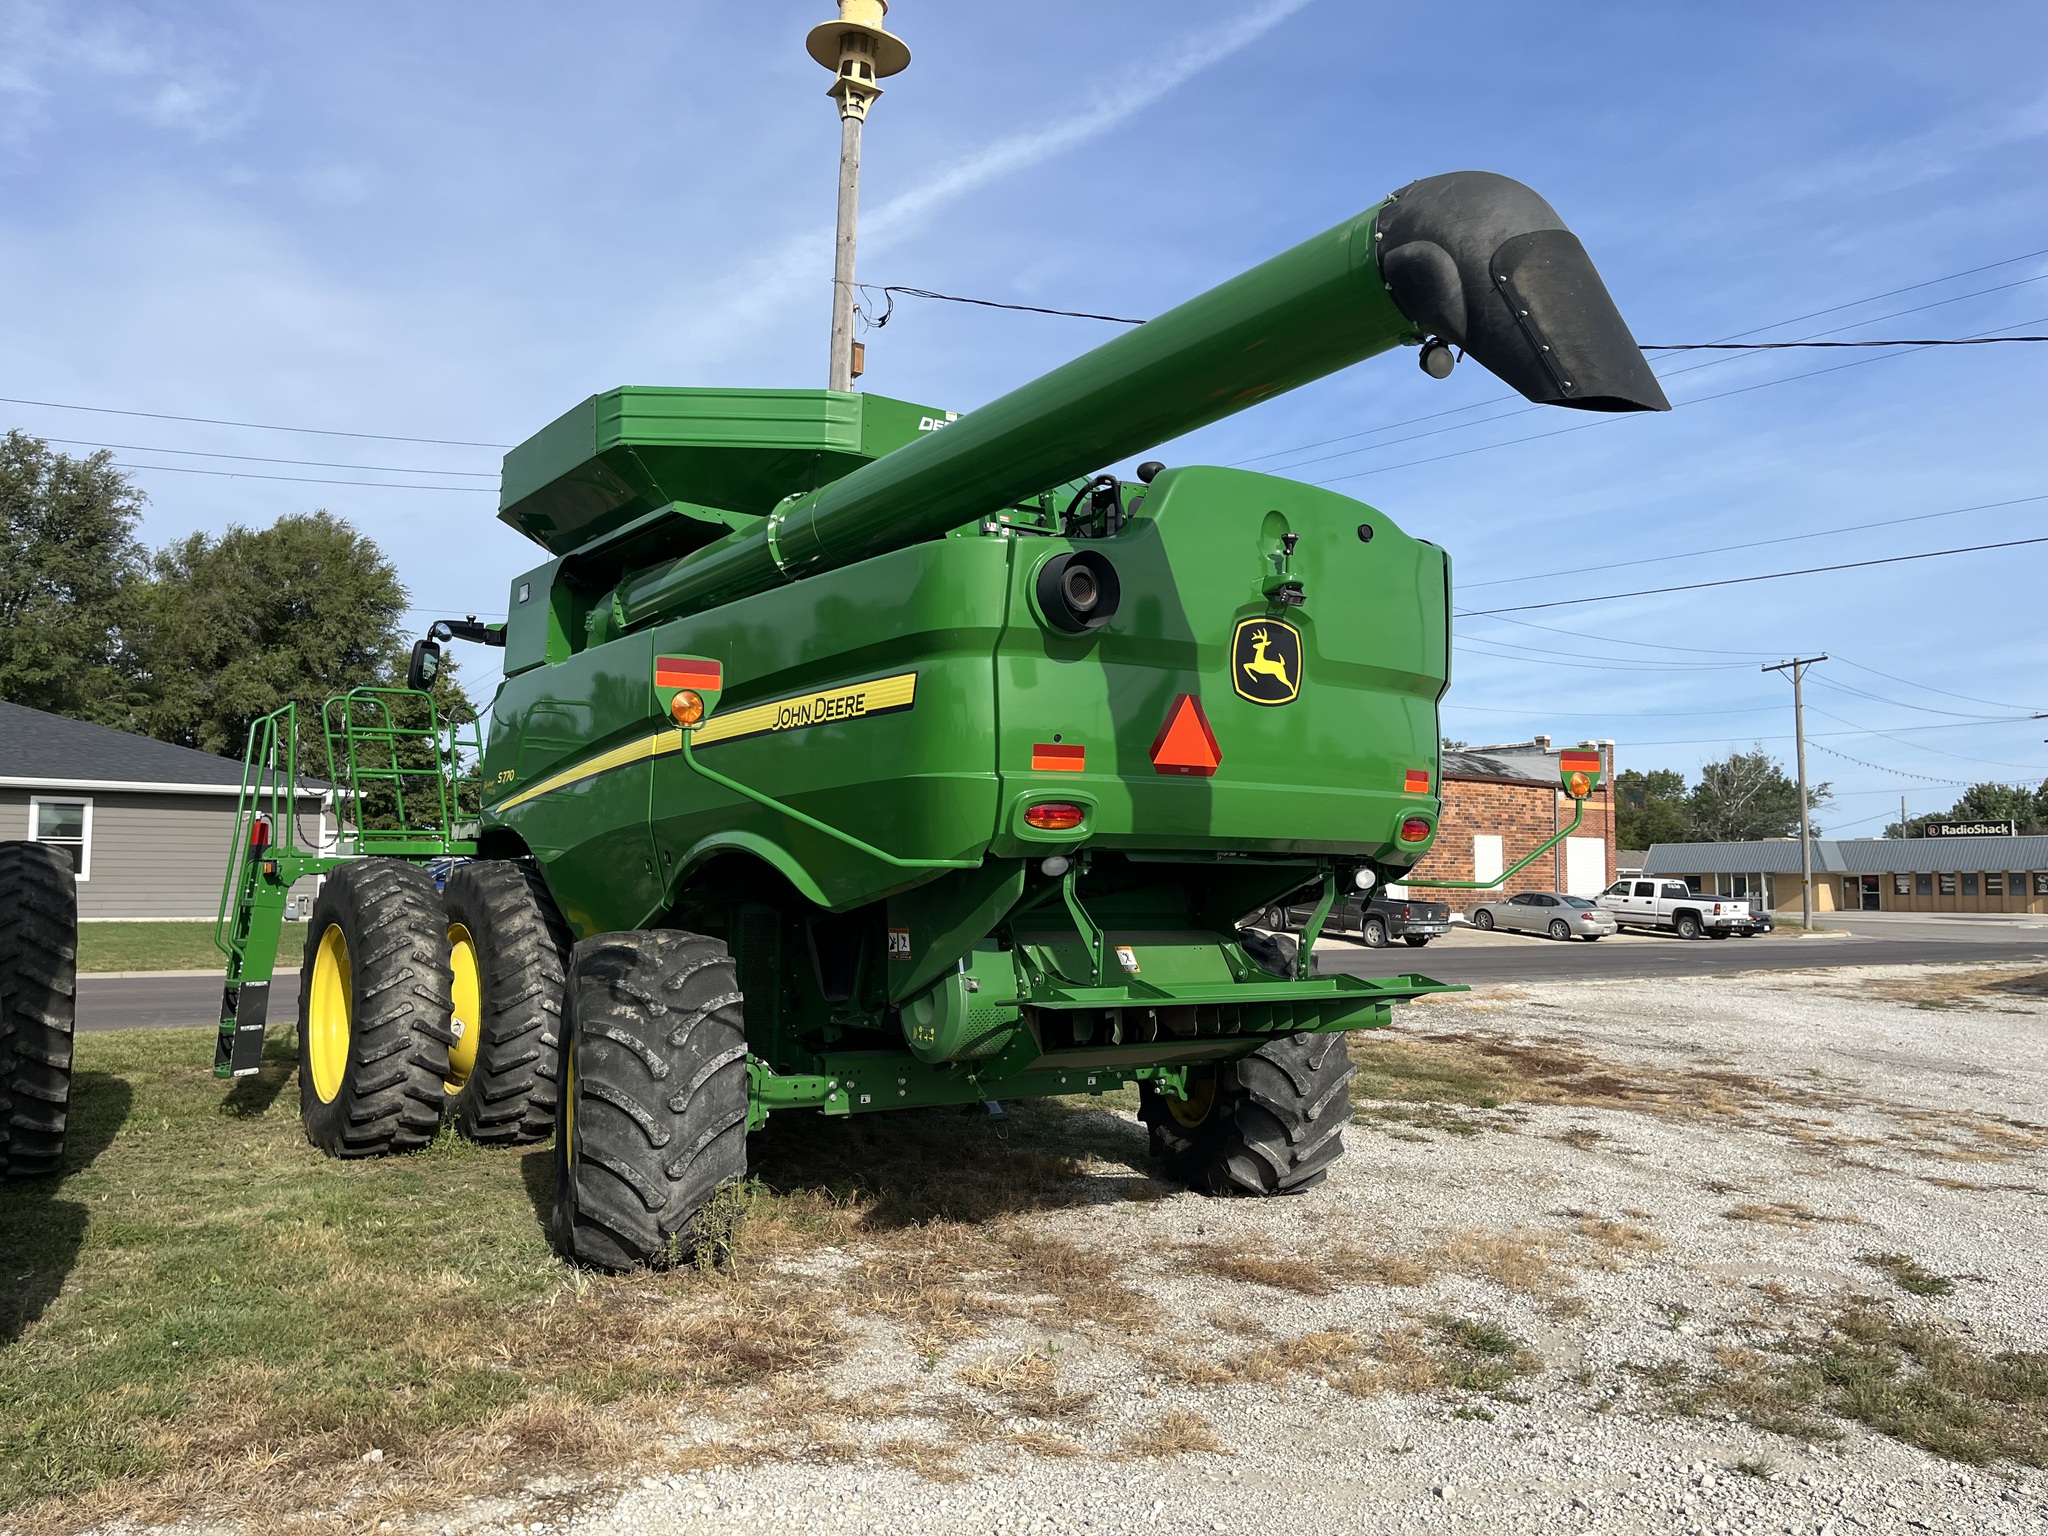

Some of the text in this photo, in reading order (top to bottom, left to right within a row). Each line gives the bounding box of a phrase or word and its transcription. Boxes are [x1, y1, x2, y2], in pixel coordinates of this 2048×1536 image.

[918, 416, 950, 431] DE
[772, 693, 866, 728] JOHN DEERE
[497, 769, 515, 784] S770
[1941, 823, 2009, 835] RadioShack
